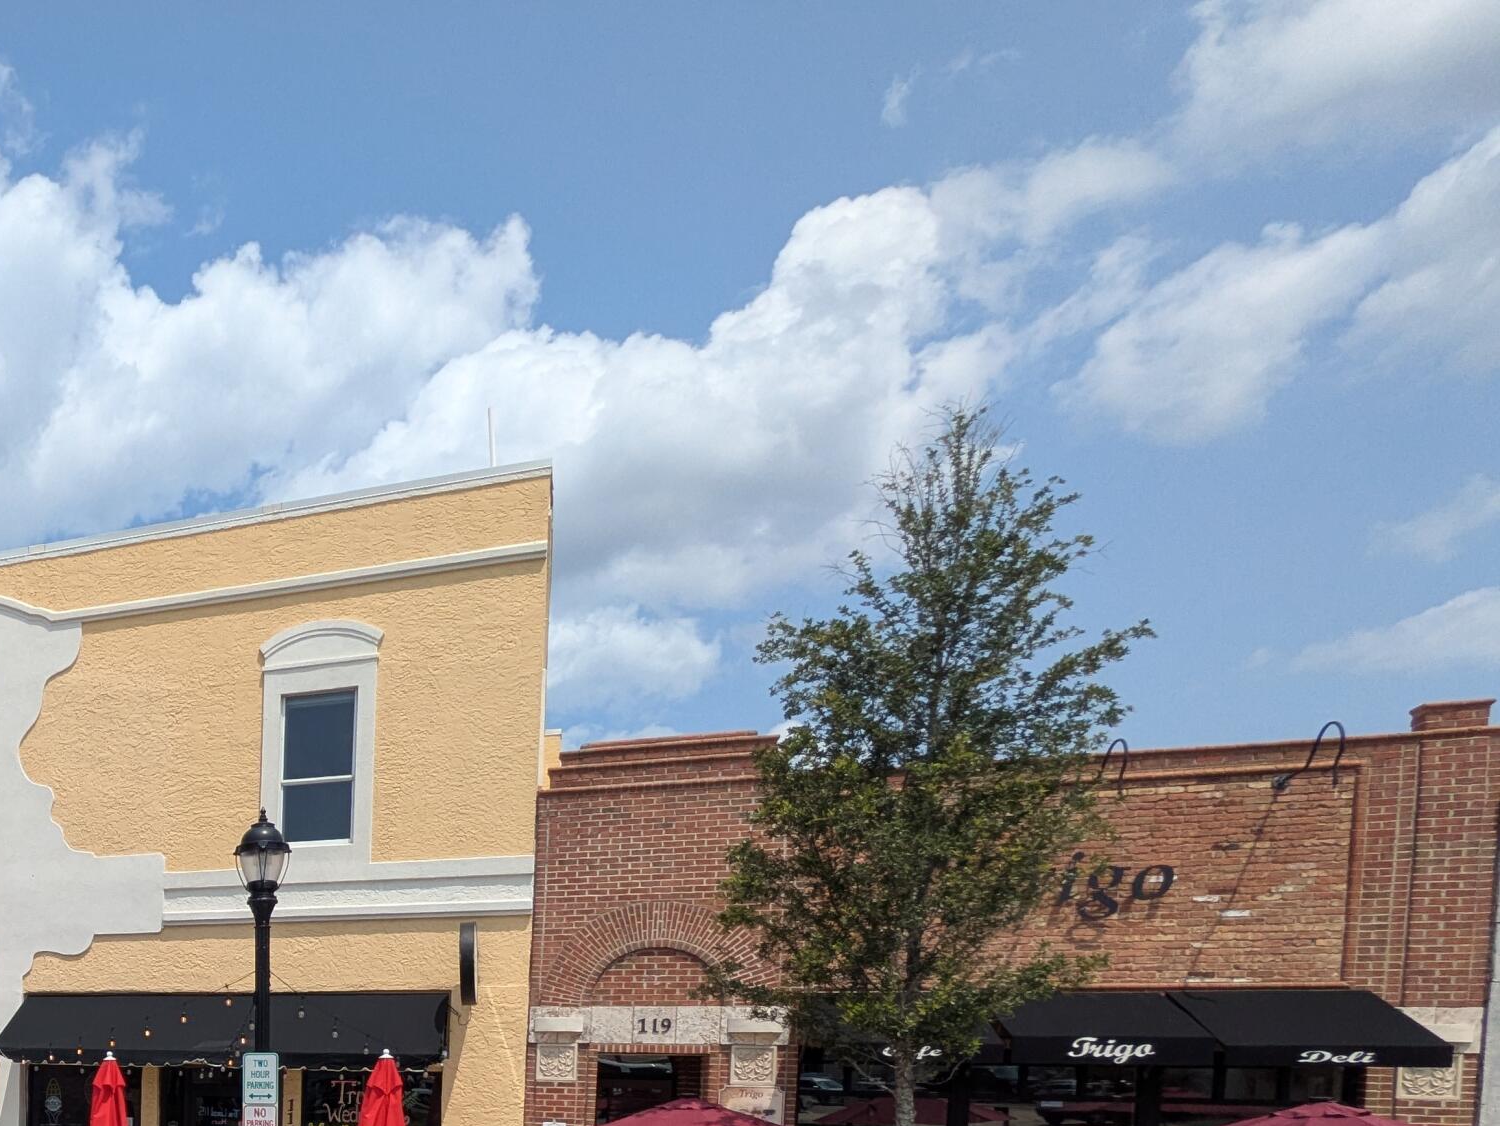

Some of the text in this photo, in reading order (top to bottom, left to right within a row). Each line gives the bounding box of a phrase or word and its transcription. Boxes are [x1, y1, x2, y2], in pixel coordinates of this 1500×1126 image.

[1055, 851, 1175, 919] igo
[637, 1018, 672, 1034] 119
[1067, 1036, 1156, 1064] Trigo
[1297, 1050, 1375, 1063] Deli
[253, 1059, 268, 1067] TWO
[250, 1070, 270, 1078] HOUR
[246, 1081, 274, 1089] PARKING
[253, 1108, 266, 1117] NO
